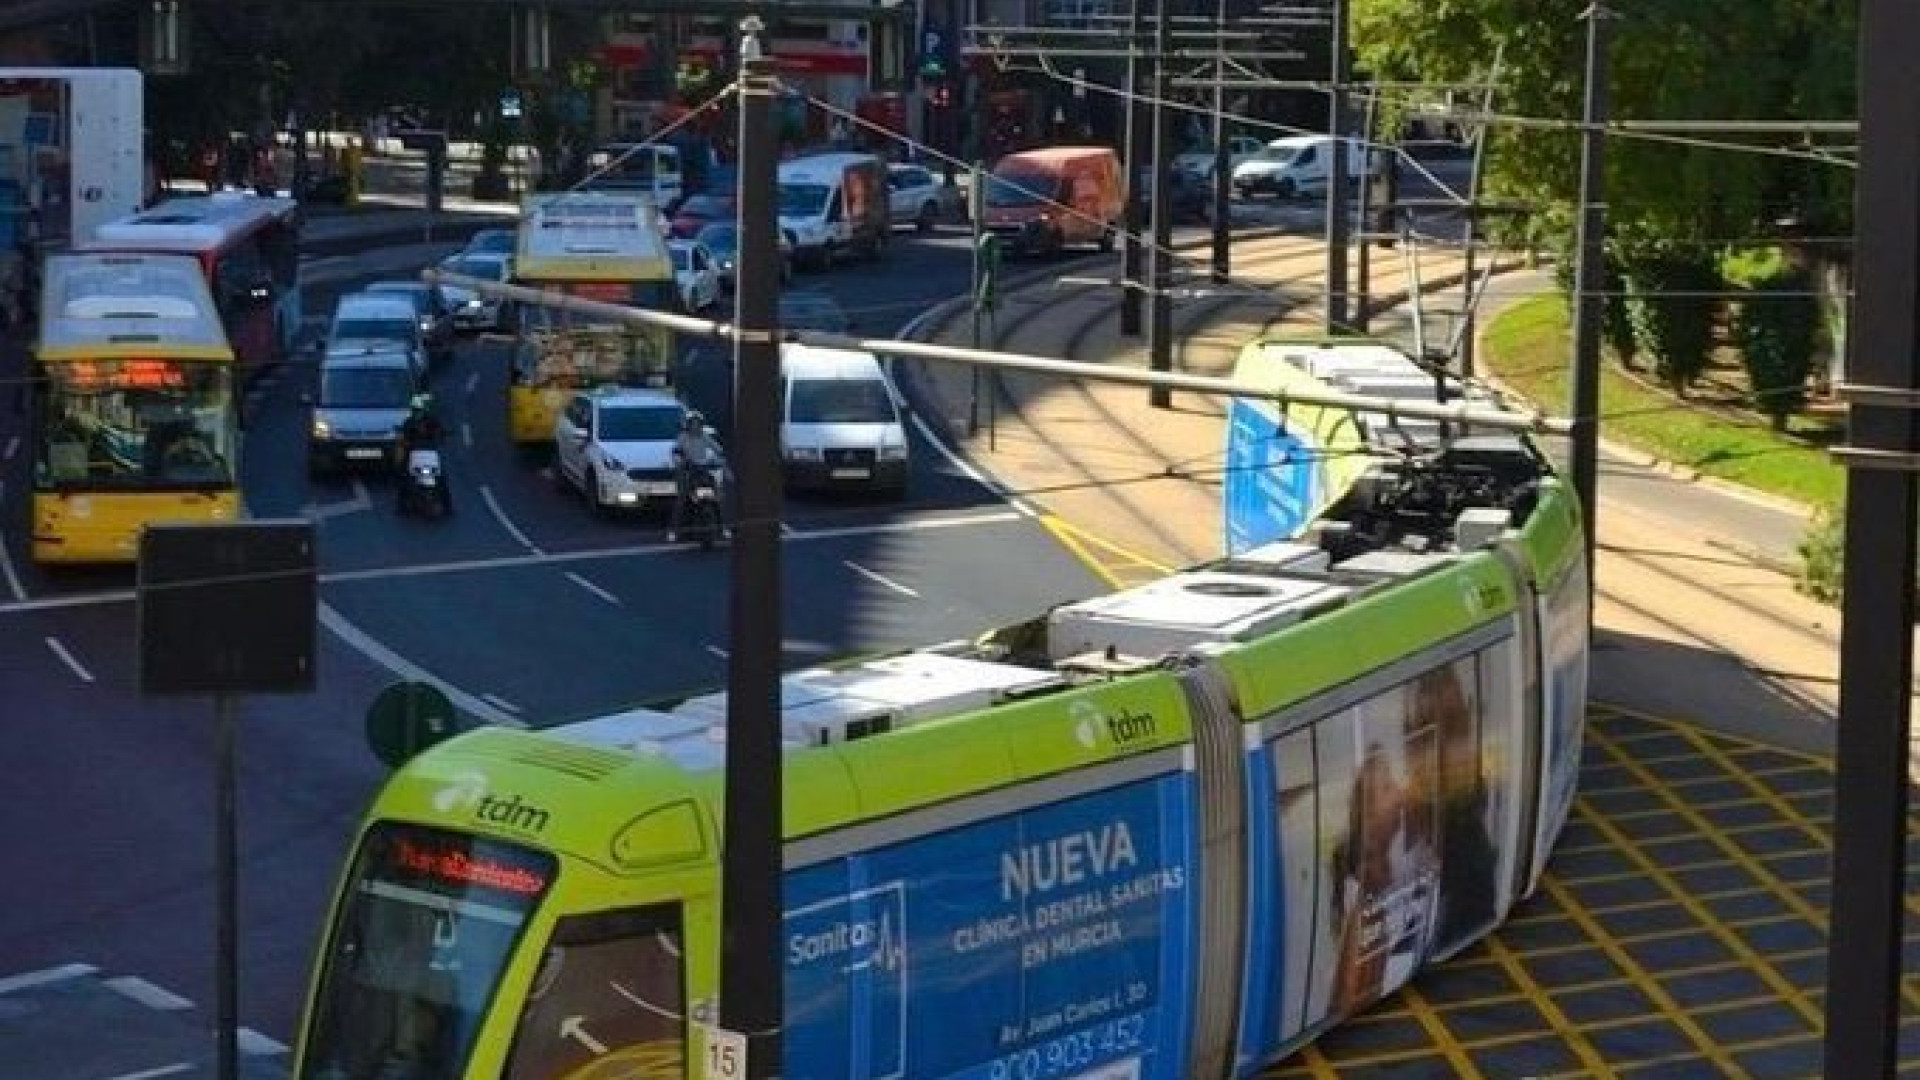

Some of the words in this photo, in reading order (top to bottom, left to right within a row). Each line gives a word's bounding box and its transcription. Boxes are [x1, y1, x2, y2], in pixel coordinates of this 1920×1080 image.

[1108, 708, 1156, 745] tdm
[477, 794, 549, 833] tdm
[1001, 821, 1138, 901] NUEVA
[1036, 892, 1107, 929] DENTAL
[1111, 866, 1184, 905] SANITAS
[1022, 940, 1049, 969] EN
[1051, 920, 1122, 956] MURCIA
[710, 1043, 737, 1077] 15
